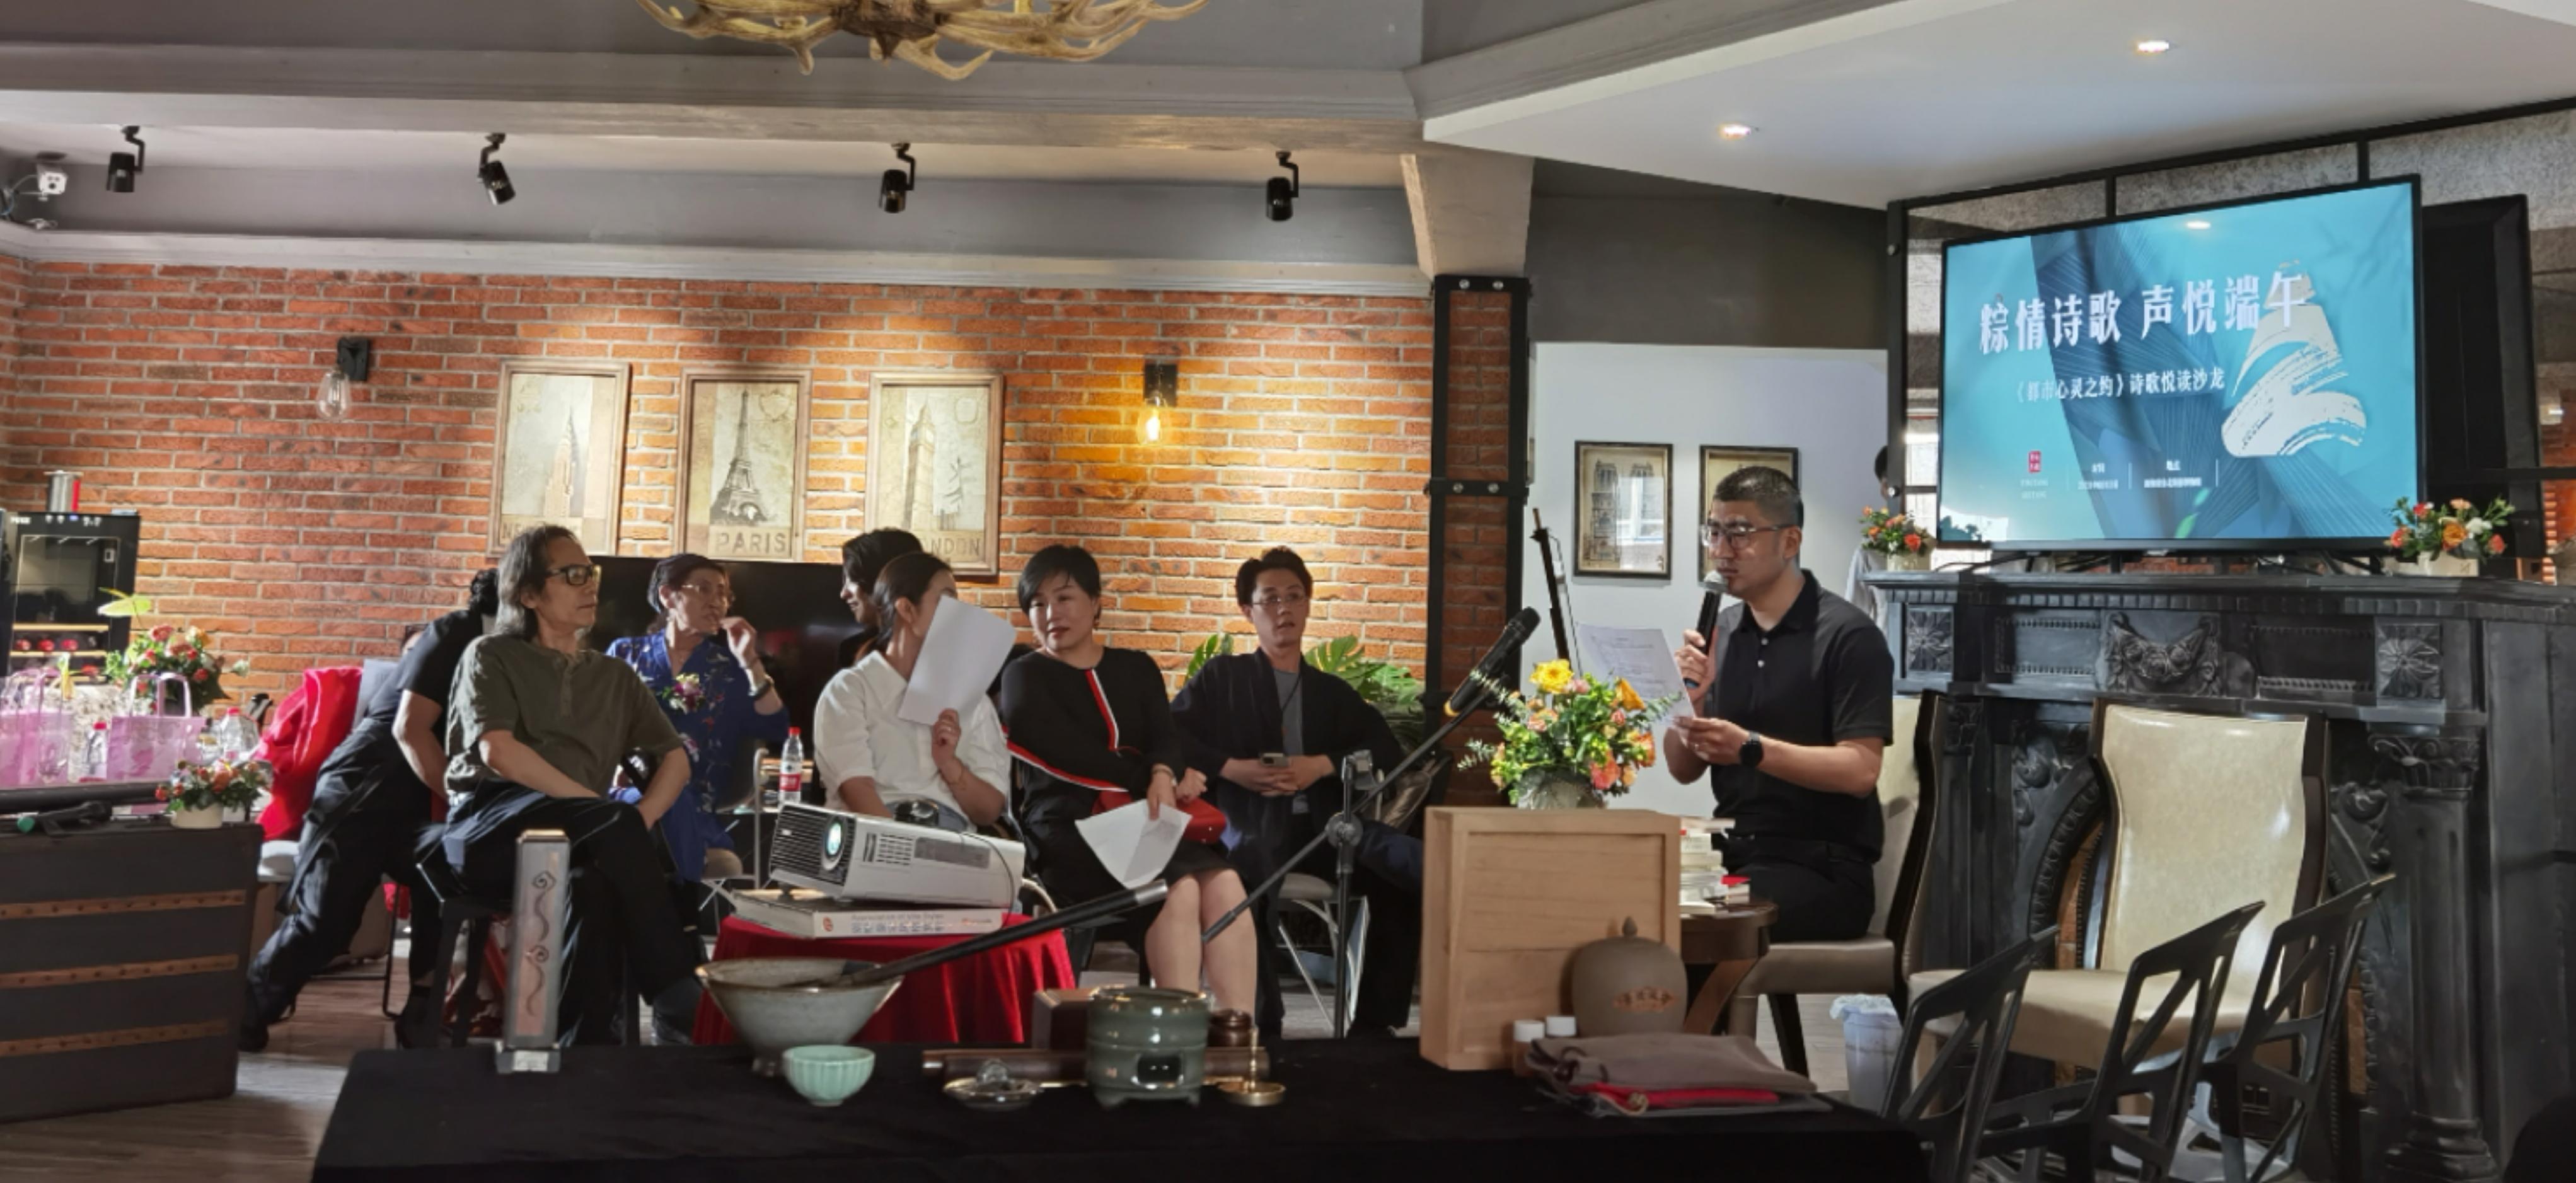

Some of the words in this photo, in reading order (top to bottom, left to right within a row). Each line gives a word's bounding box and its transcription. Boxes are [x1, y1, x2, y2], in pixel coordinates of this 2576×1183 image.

[1980, 289, 2122, 355] 粽情诗歌
[2141, 271, 2307, 340] 声悦端午
[715, 532, 787, 553] PARIS
